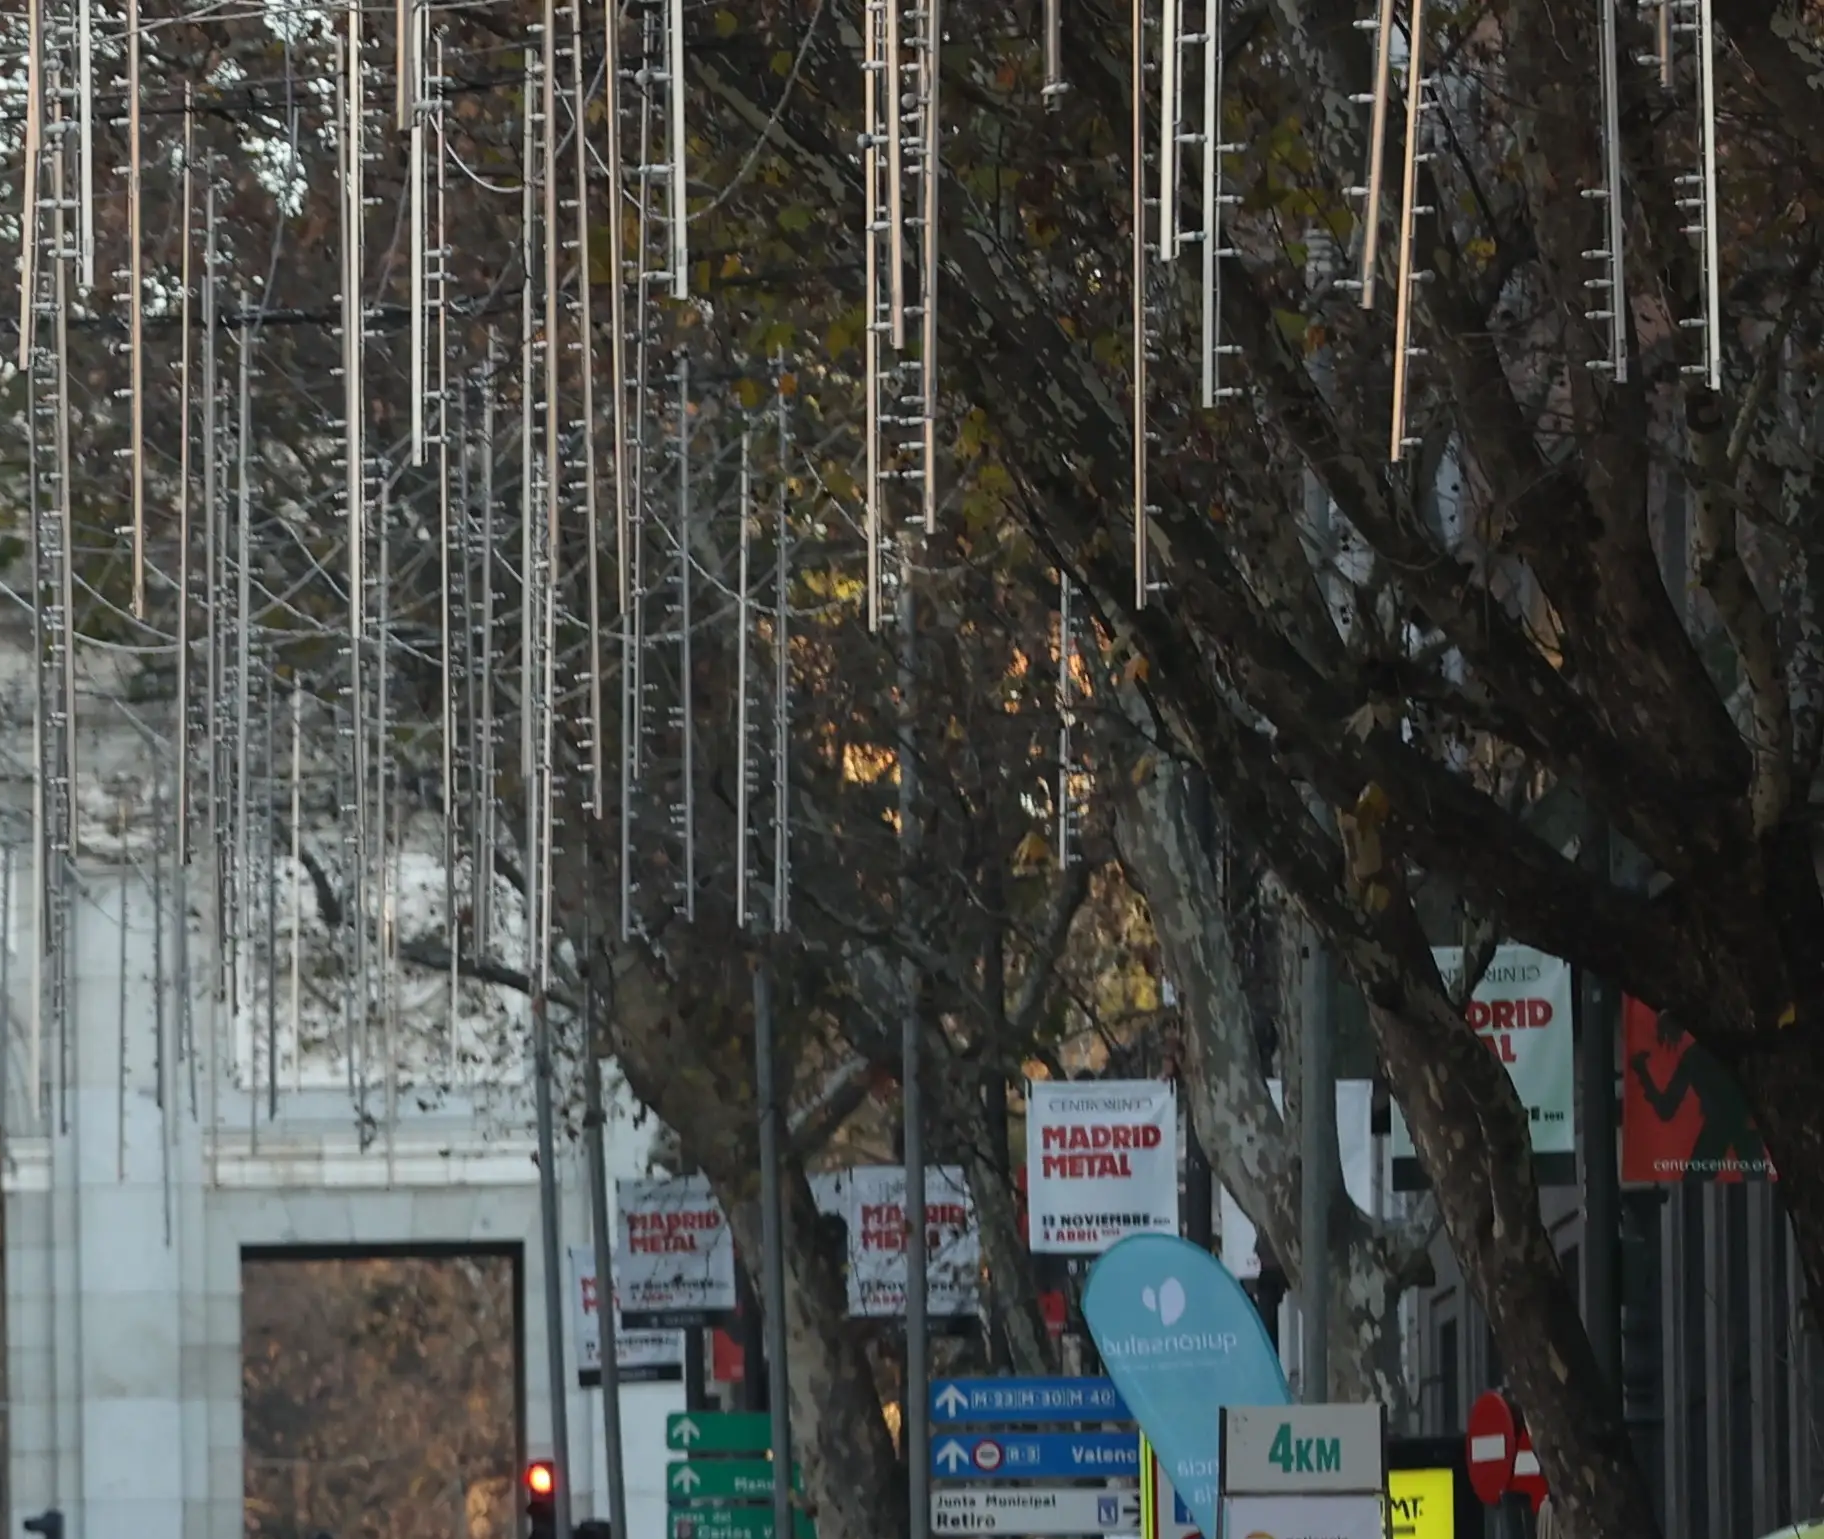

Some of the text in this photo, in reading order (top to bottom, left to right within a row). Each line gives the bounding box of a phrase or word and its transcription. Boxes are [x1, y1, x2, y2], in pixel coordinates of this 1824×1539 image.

[1466, 997, 1554, 1030] DRID
[1042, 1124, 1162, 1150] MADRID
[1042, 1153, 1132, 1179] METAL
[861, 1204, 967, 1224] MARID
[1060, 1212, 1151, 1227] NOVIEMBRE
[1071, 1445, 1138, 1464] Valenc
[1268, 1421, 1342, 1474] 4KM
[937, 1492, 1056, 1510] Junta Municipal
[937, 1511, 996, 1529] Retiro
